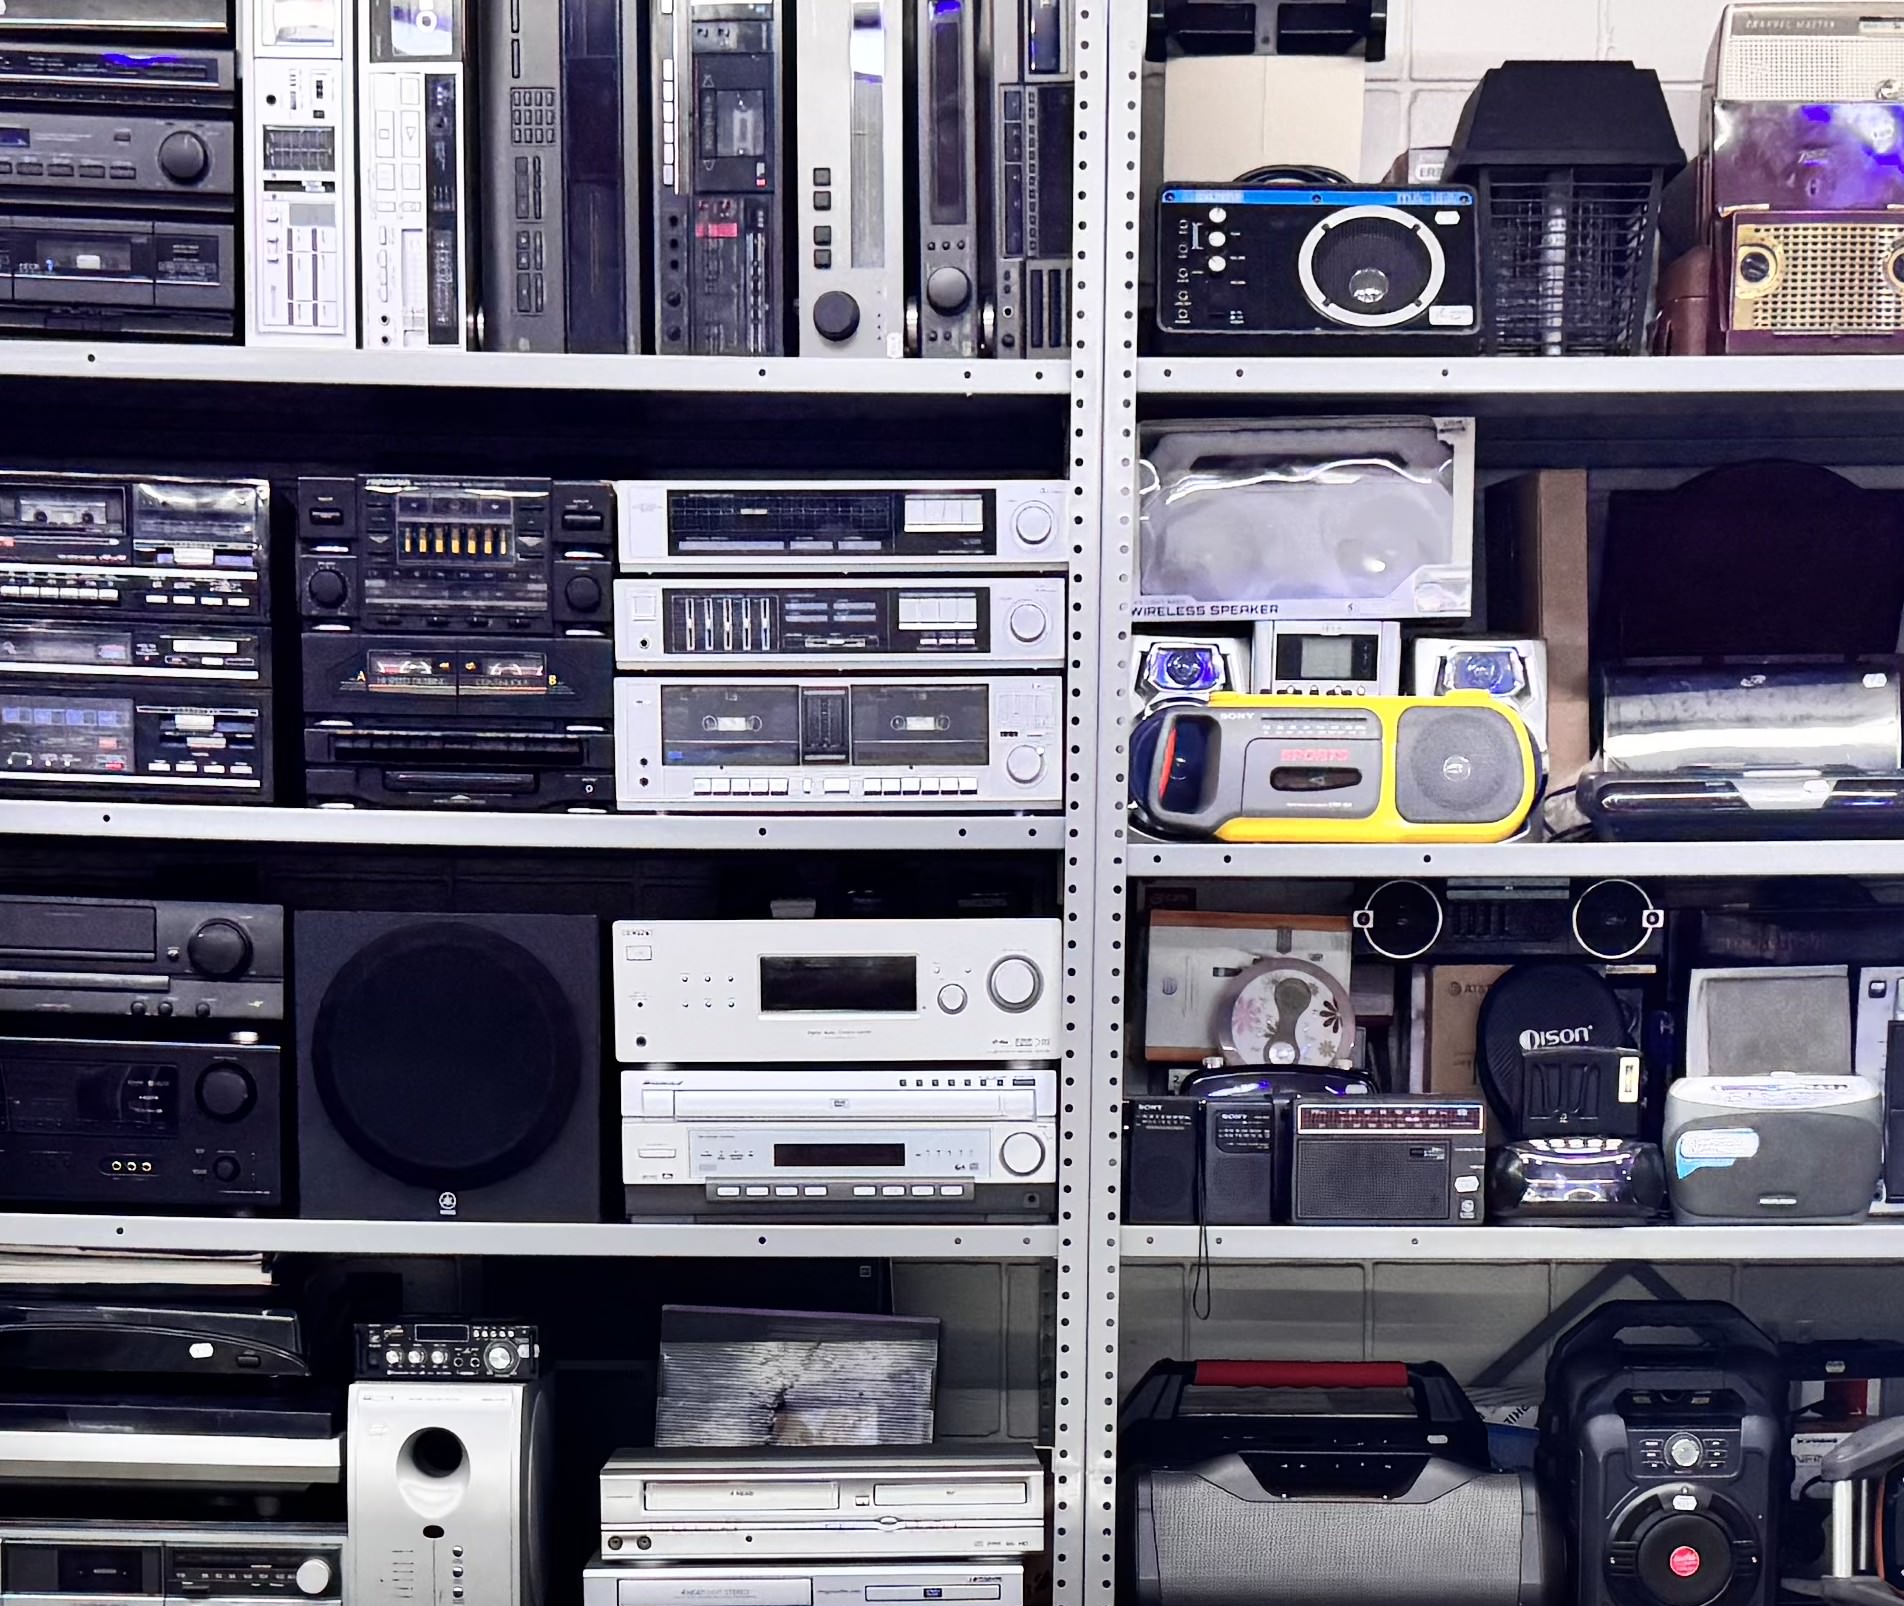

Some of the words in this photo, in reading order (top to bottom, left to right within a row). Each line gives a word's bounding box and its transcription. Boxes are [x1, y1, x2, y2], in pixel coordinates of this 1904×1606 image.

[1131, 605, 1206, 617] WIRELESS
[1209, 603, 1279, 616] SPEAKER
[1220, 712, 1254, 720] SONY
